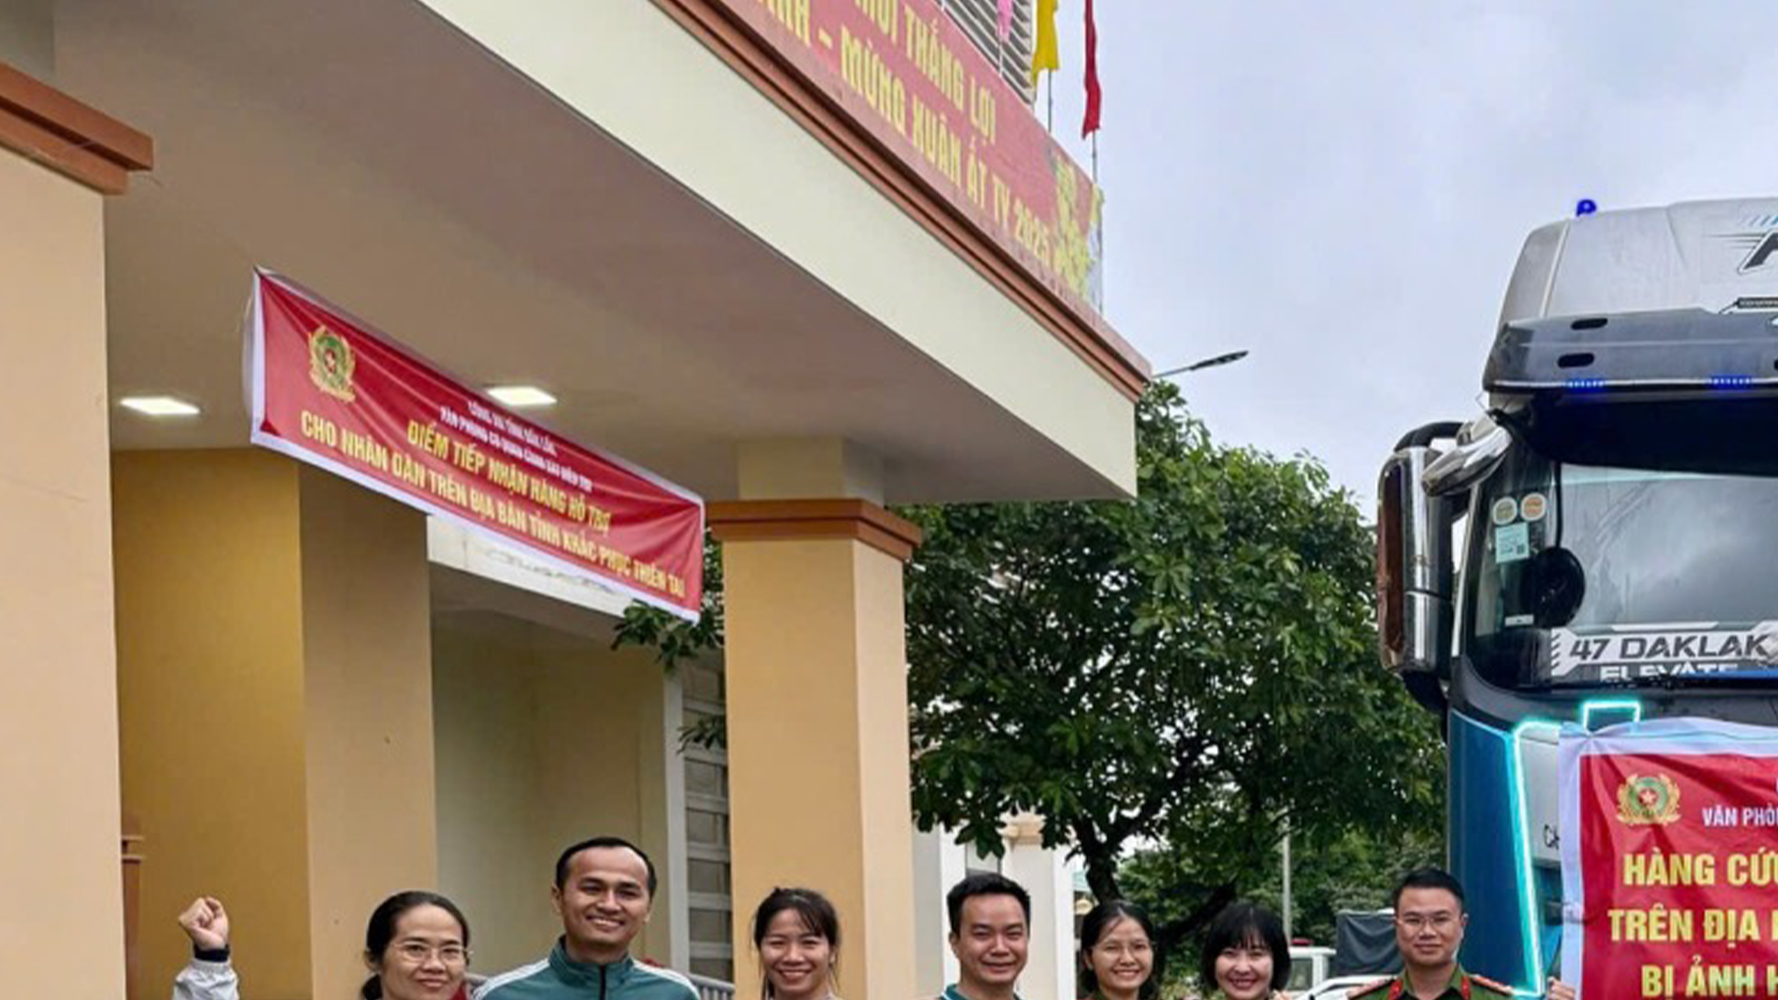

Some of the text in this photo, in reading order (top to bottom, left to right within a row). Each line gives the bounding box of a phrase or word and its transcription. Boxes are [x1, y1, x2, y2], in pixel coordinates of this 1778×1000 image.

[903, 4, 964, 111] THẮNG
[841, 24, 906, 136] MỪNG
[912, 93, 963, 187] XUÂN
[1013, 196, 1051, 267] 2025
[407, 418, 449, 460] ĐIỂM
[452, 441, 486, 475] TIẾP
[488, 458, 529, 496] NHẬN
[530, 477, 567, 514] HÀNG
[301, 410, 337, 448] CHO
[428, 469, 468, 507] TRÊN
[497, 500, 528, 533] BÀN
[529, 510, 561, 547] TỈNH
[633, 558, 667, 591] THIÊN
[668, 573, 687, 598] TAI
[1569, 634, 1770, 661] 47 DAKLAK
[1702, 805, 1737, 826] VĂN
[1623, 847, 1715, 886] HÀNG
[1607, 903, 1692, 941] TRÊN
[1703, 909, 1761, 948] ĐỊA
[1685, 953, 1755, 996] ẢNH
